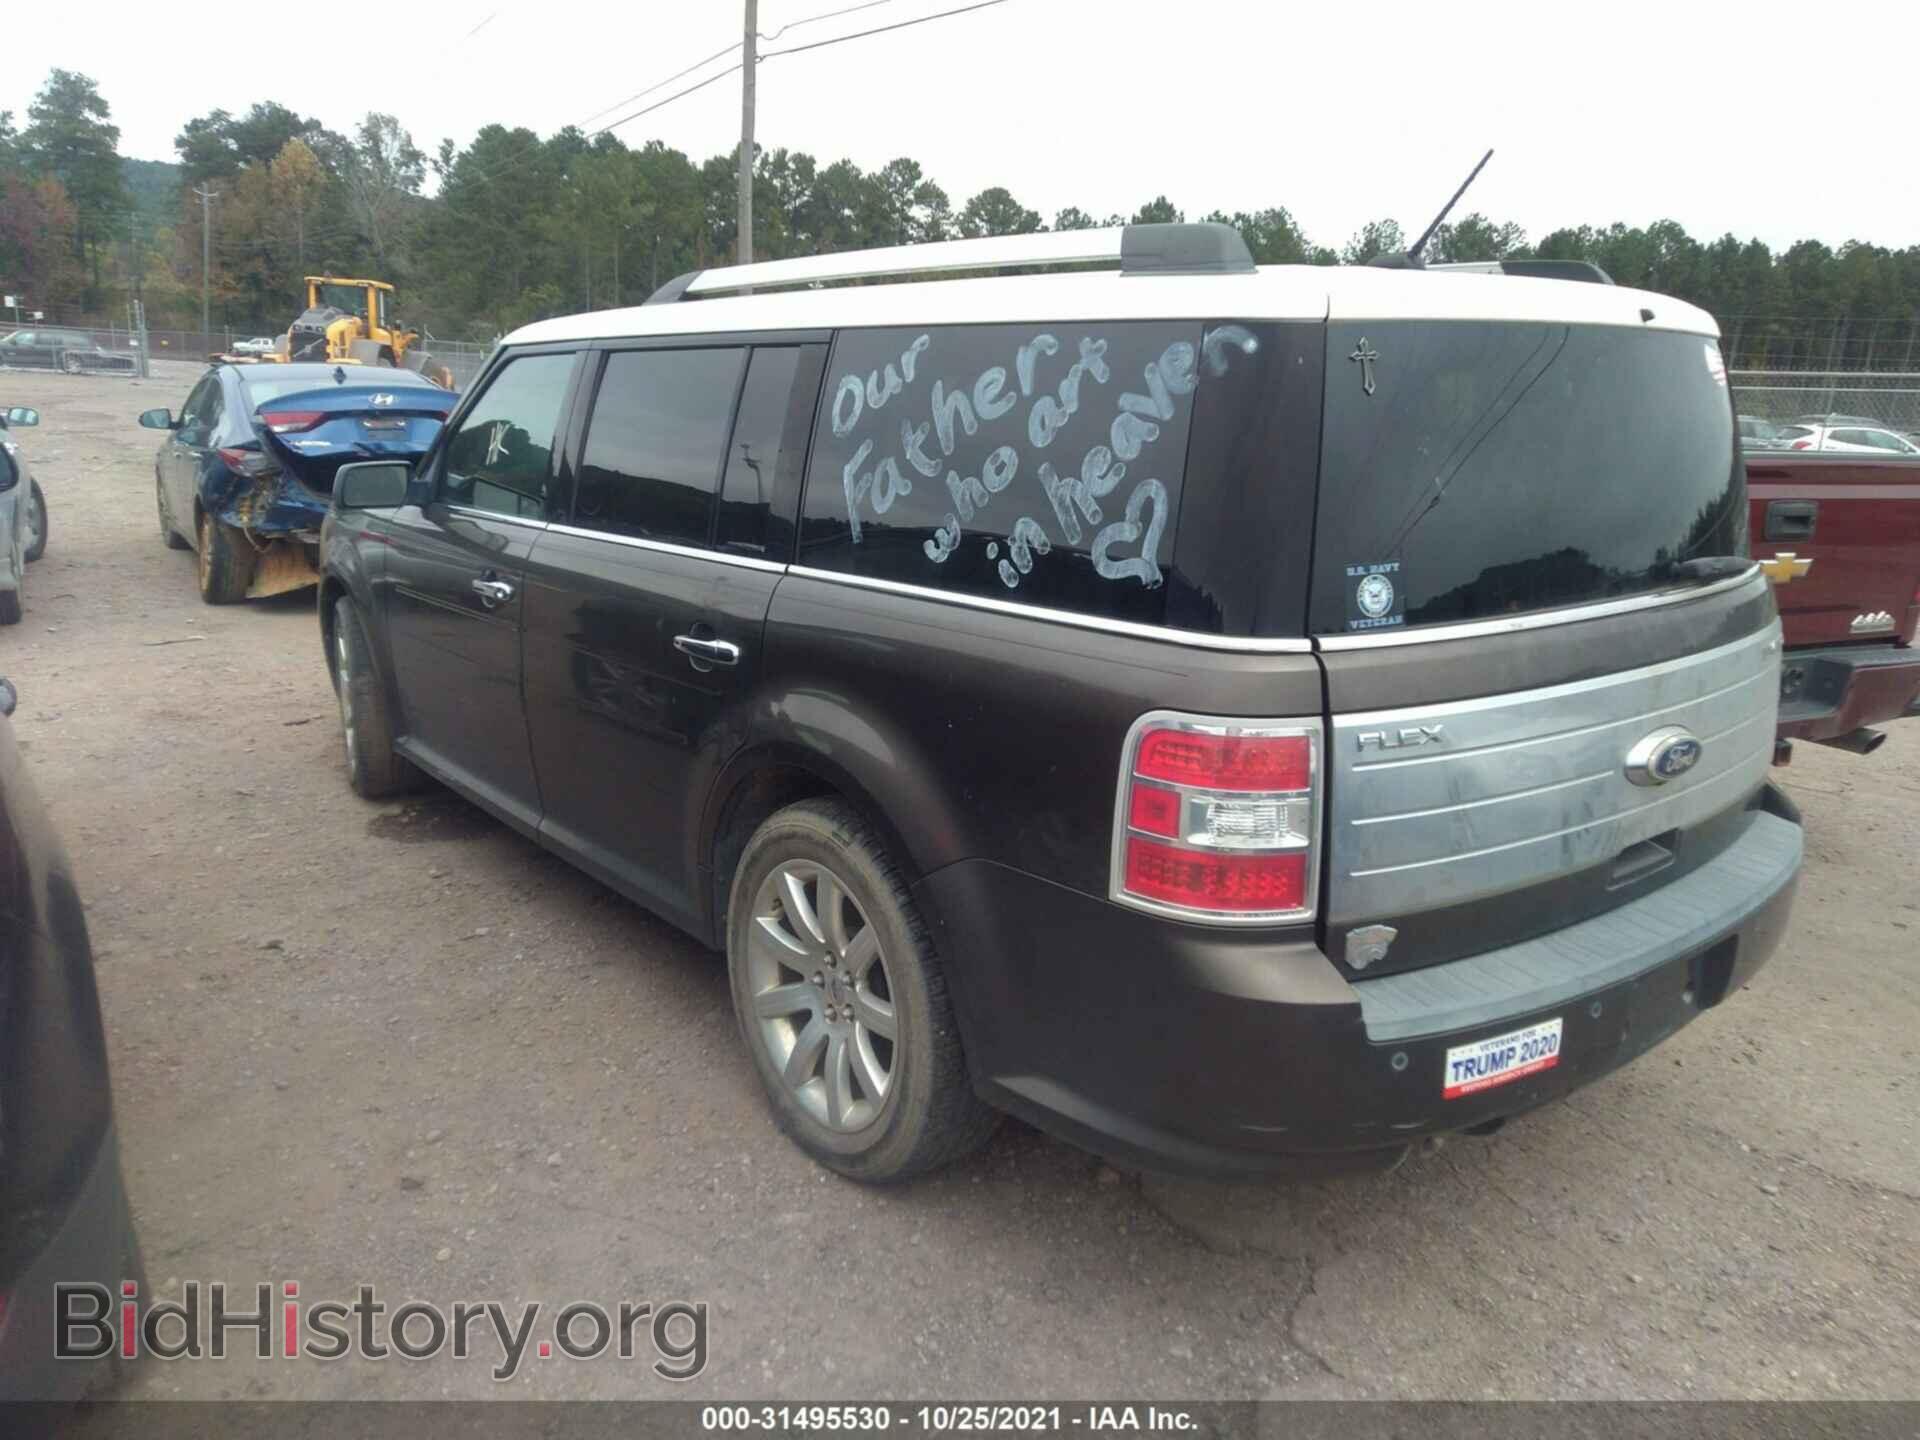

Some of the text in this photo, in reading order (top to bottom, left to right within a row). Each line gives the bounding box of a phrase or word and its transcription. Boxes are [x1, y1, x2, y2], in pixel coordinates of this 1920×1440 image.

[1028, 336, 1110, 448] art
[843, 333, 1059, 544] Father
[1357, 724, 1444, 752] FLEX
[1452, 1046, 1517, 1082] TRUMP
[1519, 1033, 1557, 1064] 2020
